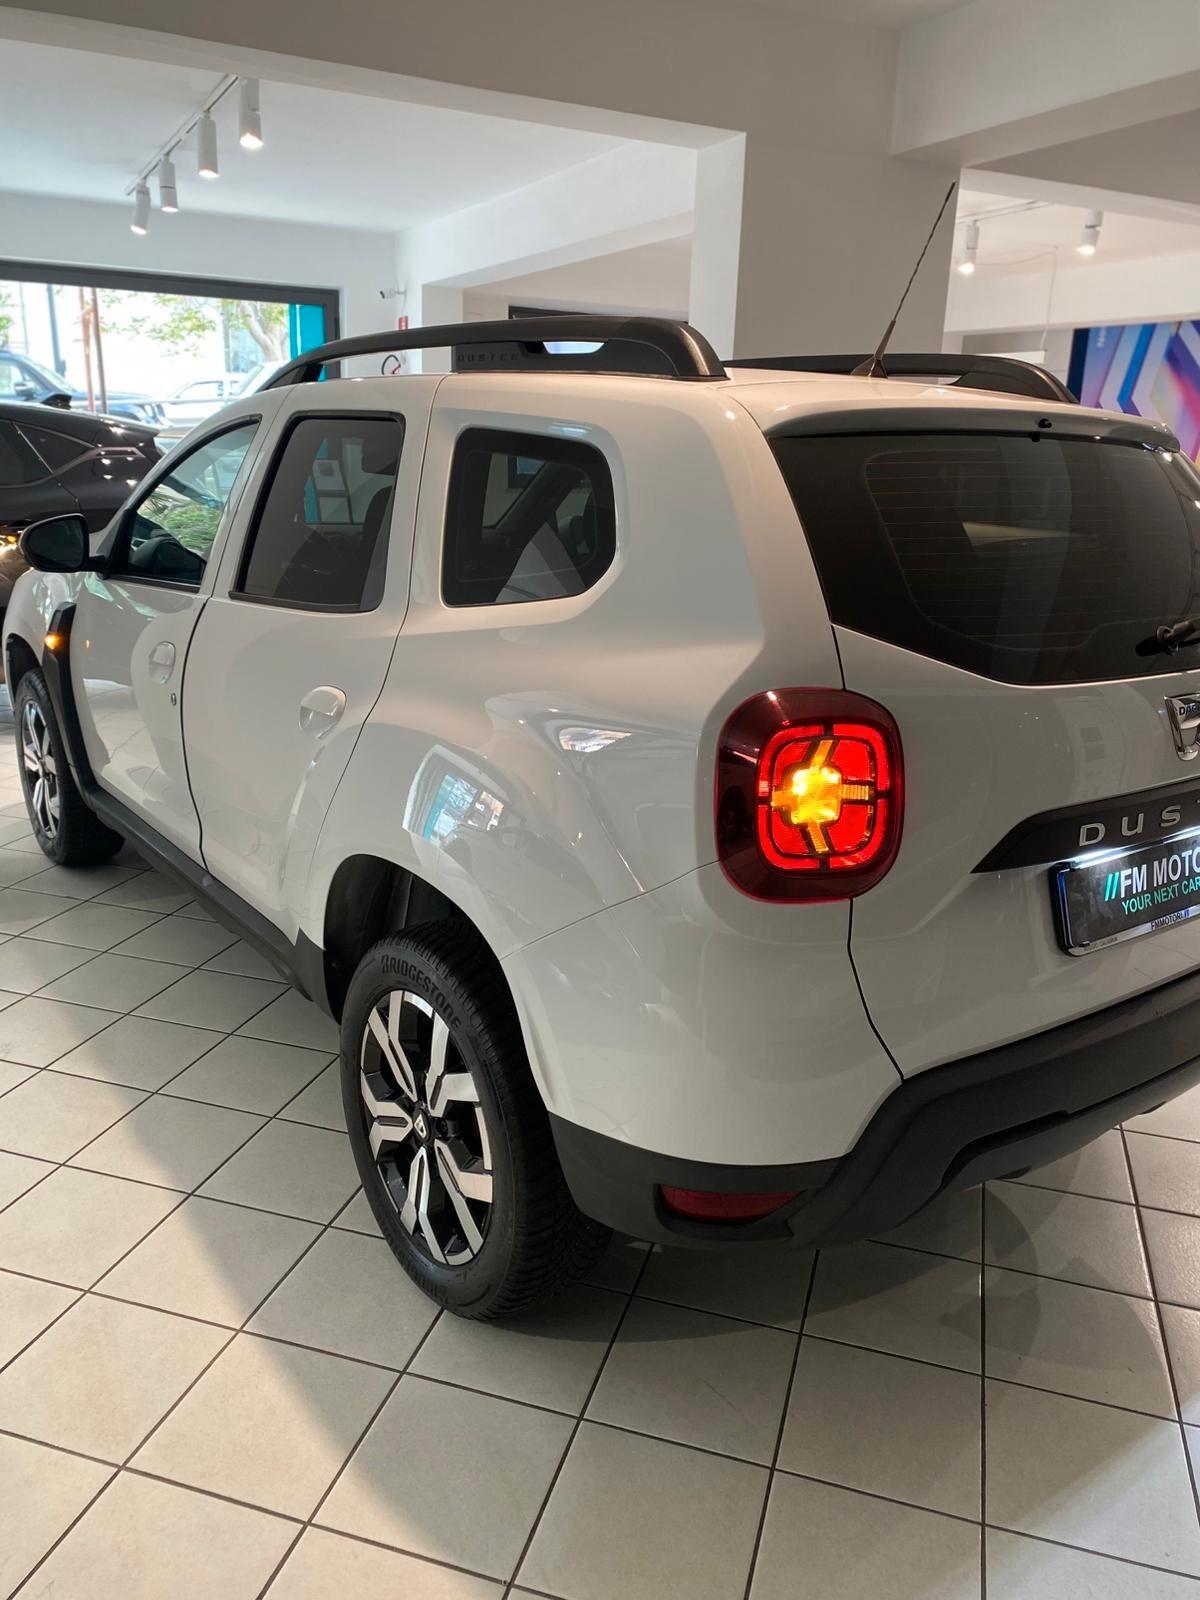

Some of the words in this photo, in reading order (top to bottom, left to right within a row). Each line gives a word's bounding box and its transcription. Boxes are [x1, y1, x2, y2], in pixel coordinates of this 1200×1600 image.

[1078, 799, 1200, 847] DUS
[1122, 893, 1152, 915] YOUR
[1153, 883, 1179, 904] NEXT
[381, 954, 462, 1032] BRIDGESTONE
